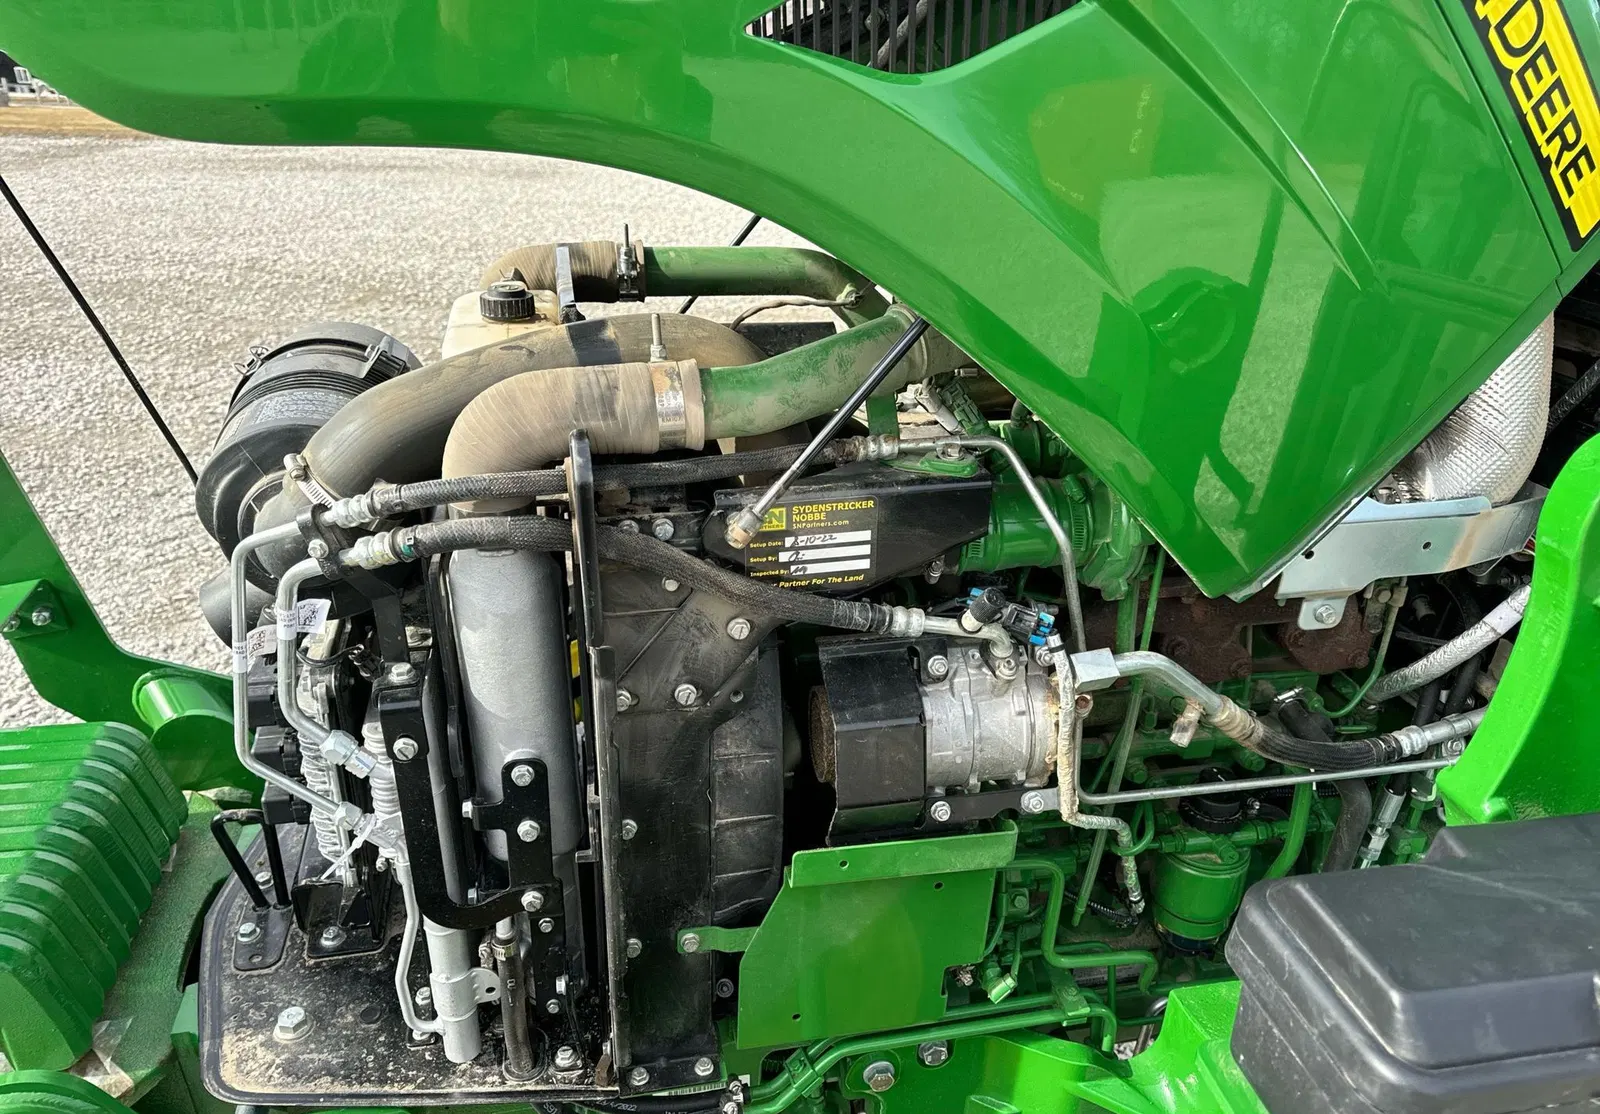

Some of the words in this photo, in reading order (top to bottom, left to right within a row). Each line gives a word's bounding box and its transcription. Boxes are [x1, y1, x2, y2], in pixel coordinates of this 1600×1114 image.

[1494, 0, 1597, 200] DEERE
[793, 501, 874, 514] SYDENSTRICKER
[792, 512, 827, 522] NOBBE
[793, 521, 849, 529] SNPartners.com
[750, 569, 779, 577] Inspected
[779, 580, 811, 588] Partner
[844, 574, 865, 582] Land
